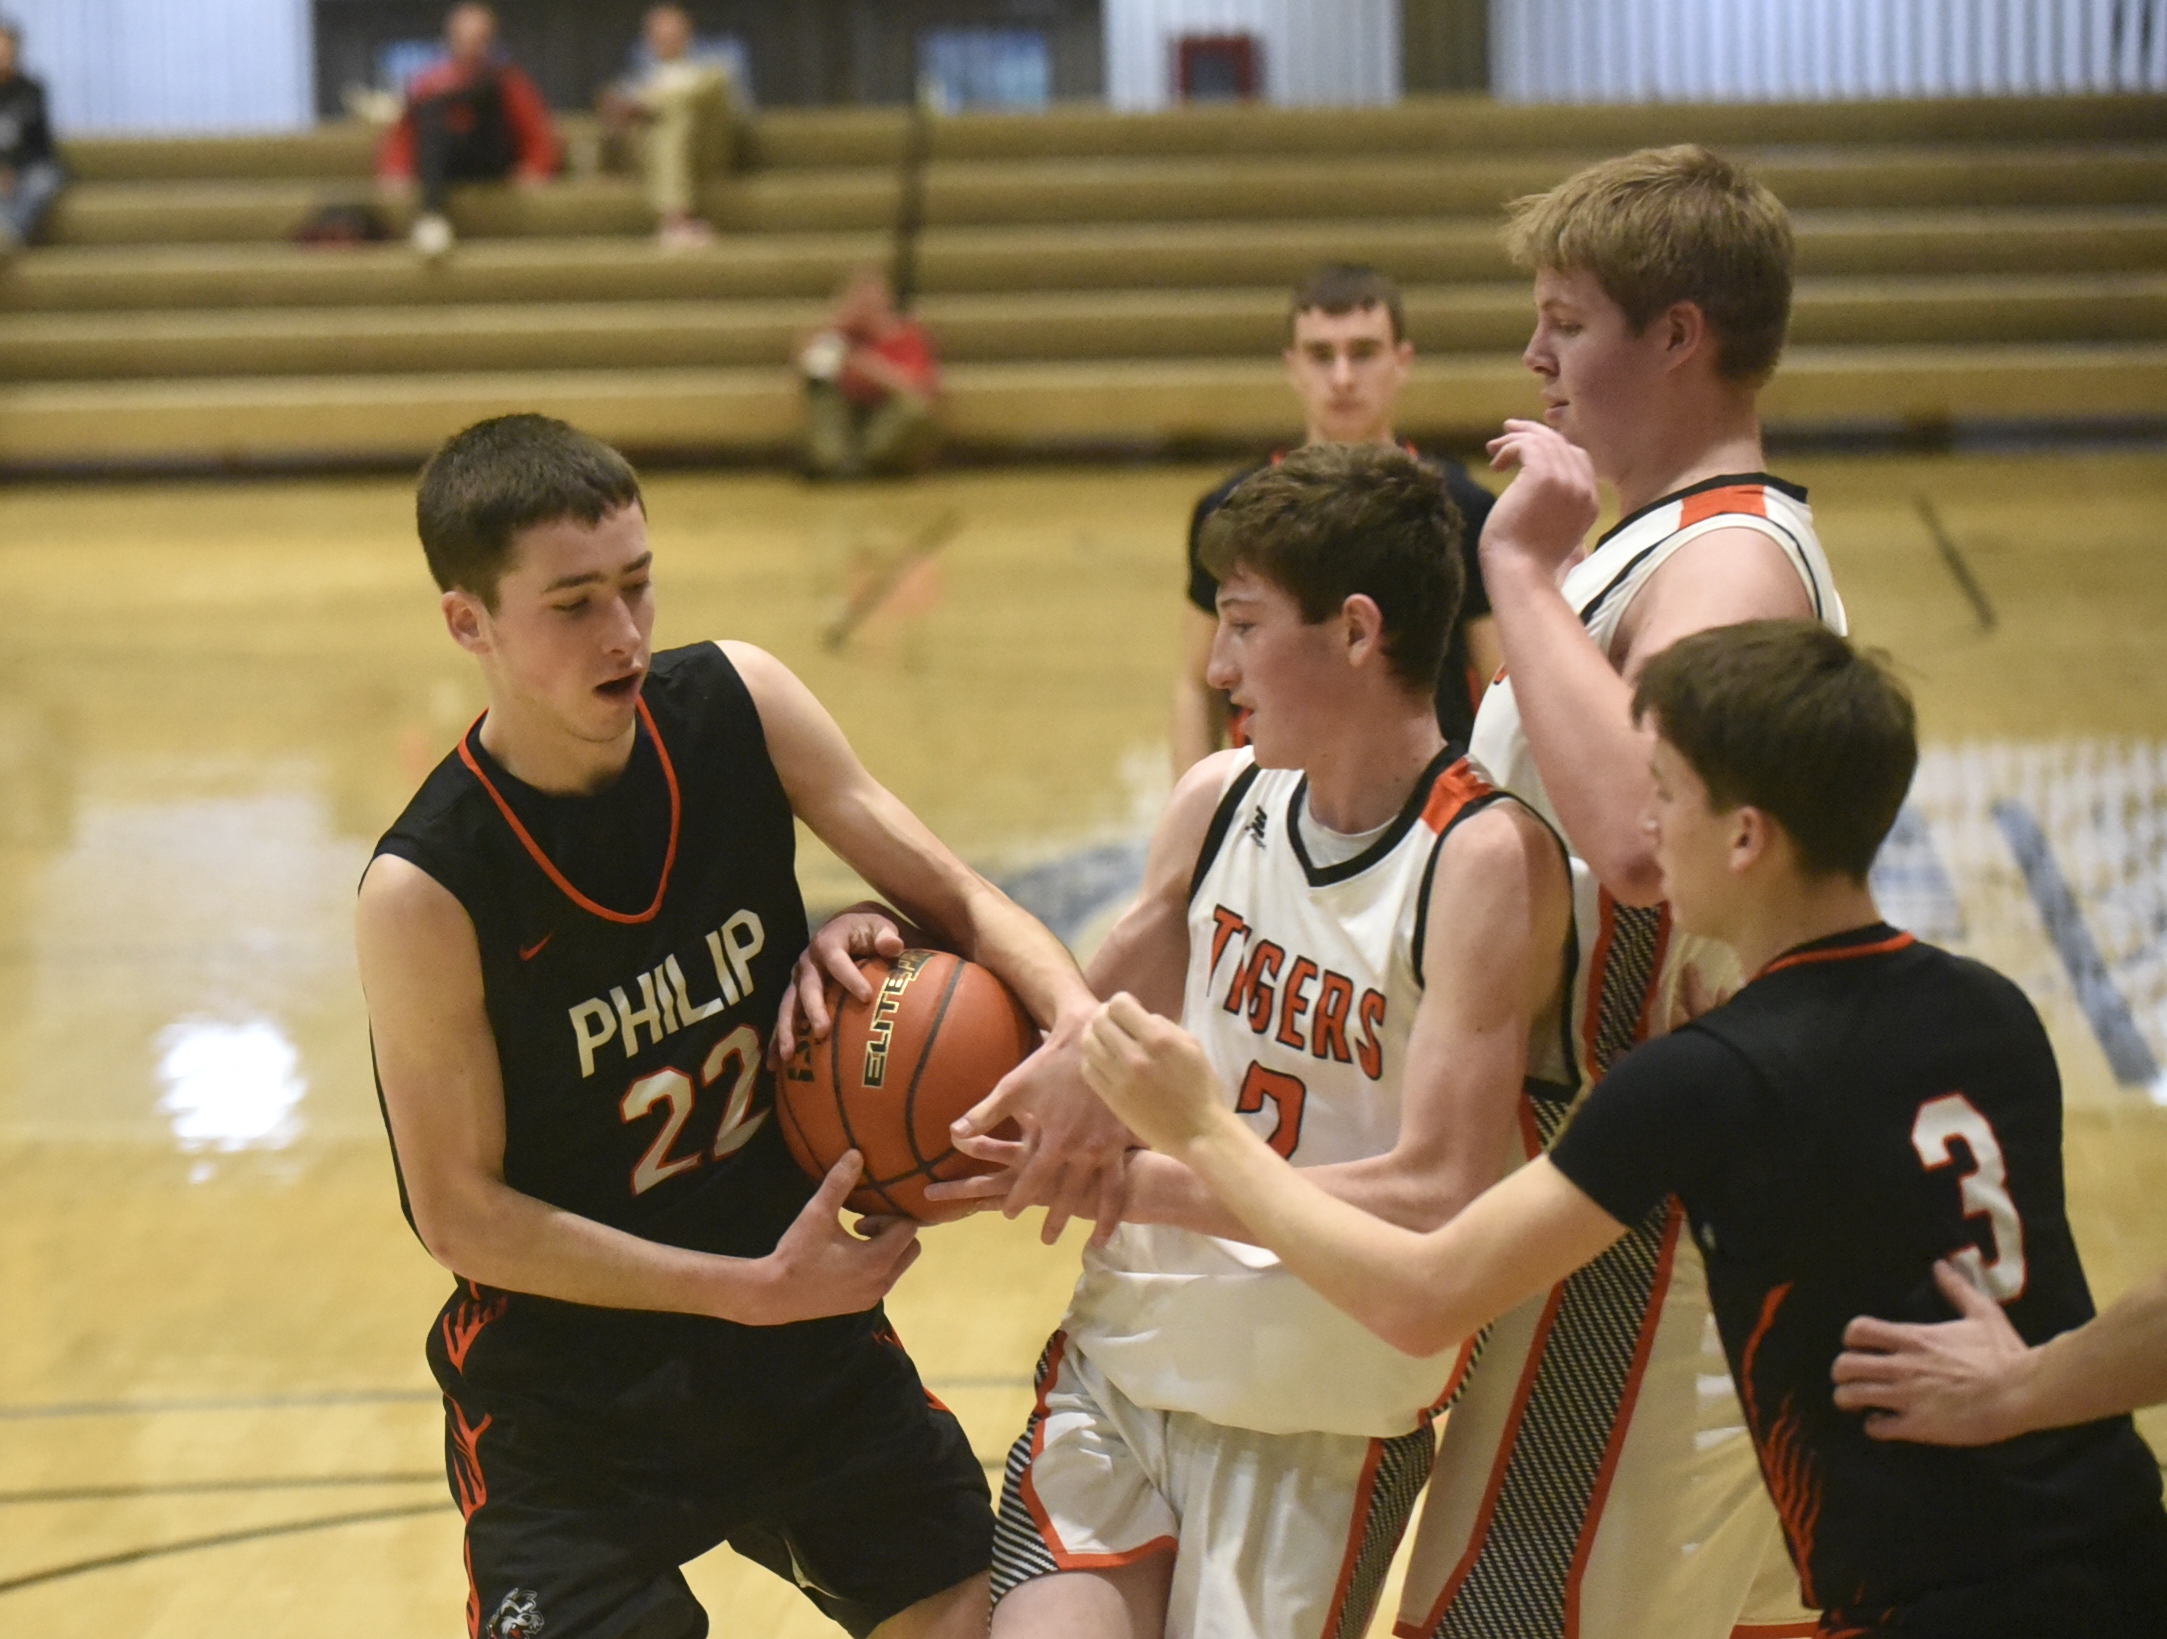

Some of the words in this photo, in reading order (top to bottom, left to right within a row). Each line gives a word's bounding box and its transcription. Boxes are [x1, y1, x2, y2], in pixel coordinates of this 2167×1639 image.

[568, 908, 766, 1079] PHILIP
[862, 970, 912, 1089] ELITE
[1206, 903, 1387, 1081] TIGERS
[618, 1022, 771, 1196] 22
[1911, 1092, 2027, 1304] 3
